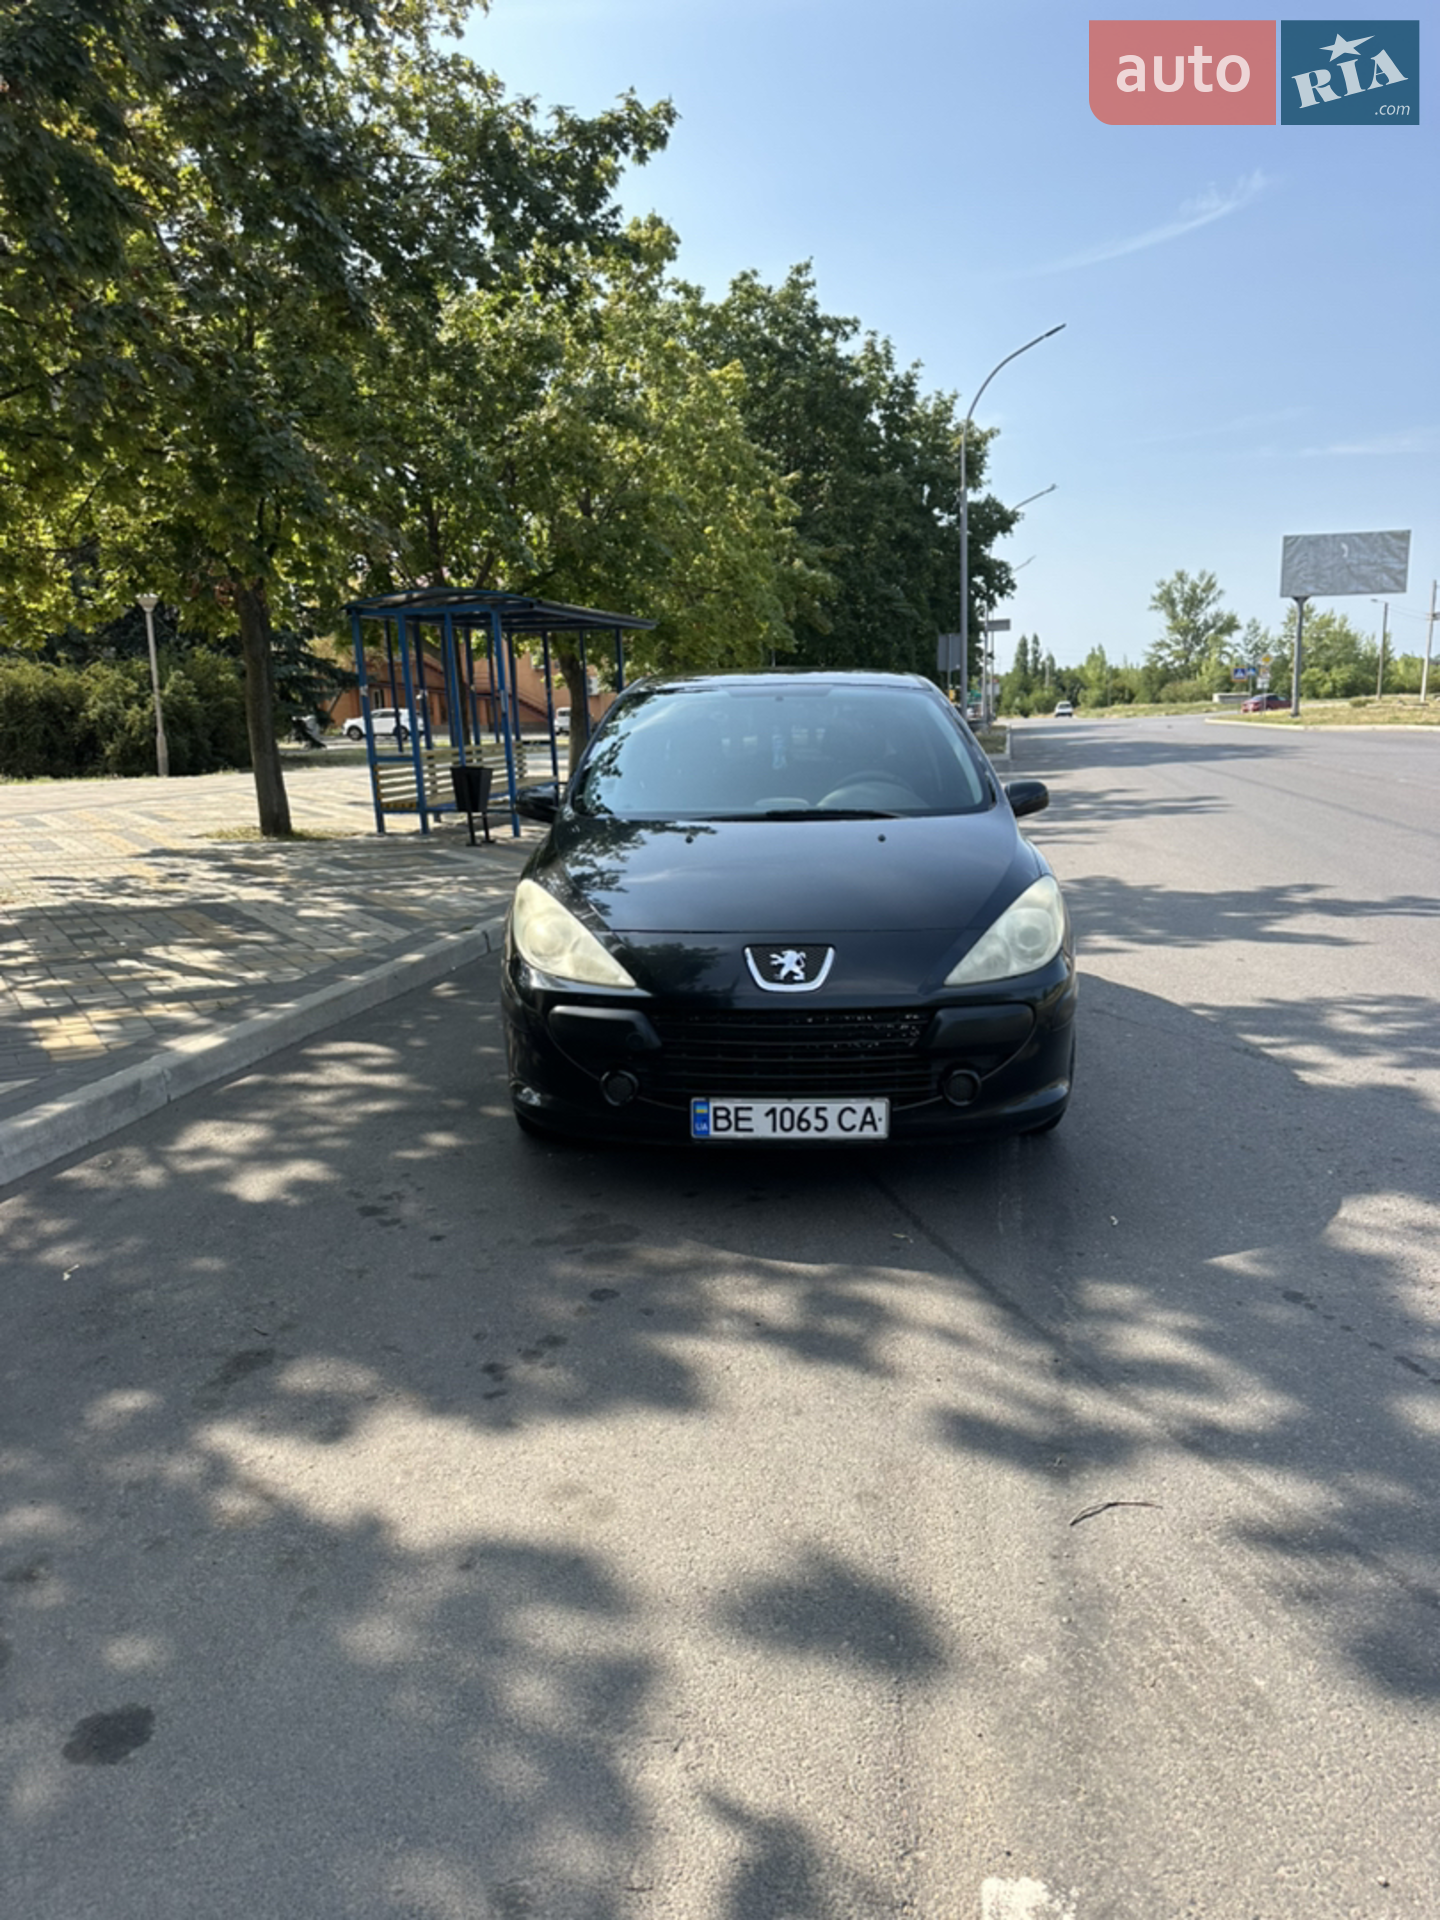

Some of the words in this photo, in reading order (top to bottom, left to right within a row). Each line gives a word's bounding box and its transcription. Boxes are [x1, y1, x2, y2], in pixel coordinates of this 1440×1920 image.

[695, 1122, 708, 1131] UA
[712, 1106, 754, 1133] BE
[764, 1106, 829, 1133] 1065
[837, 1106, 879, 1133] CA
